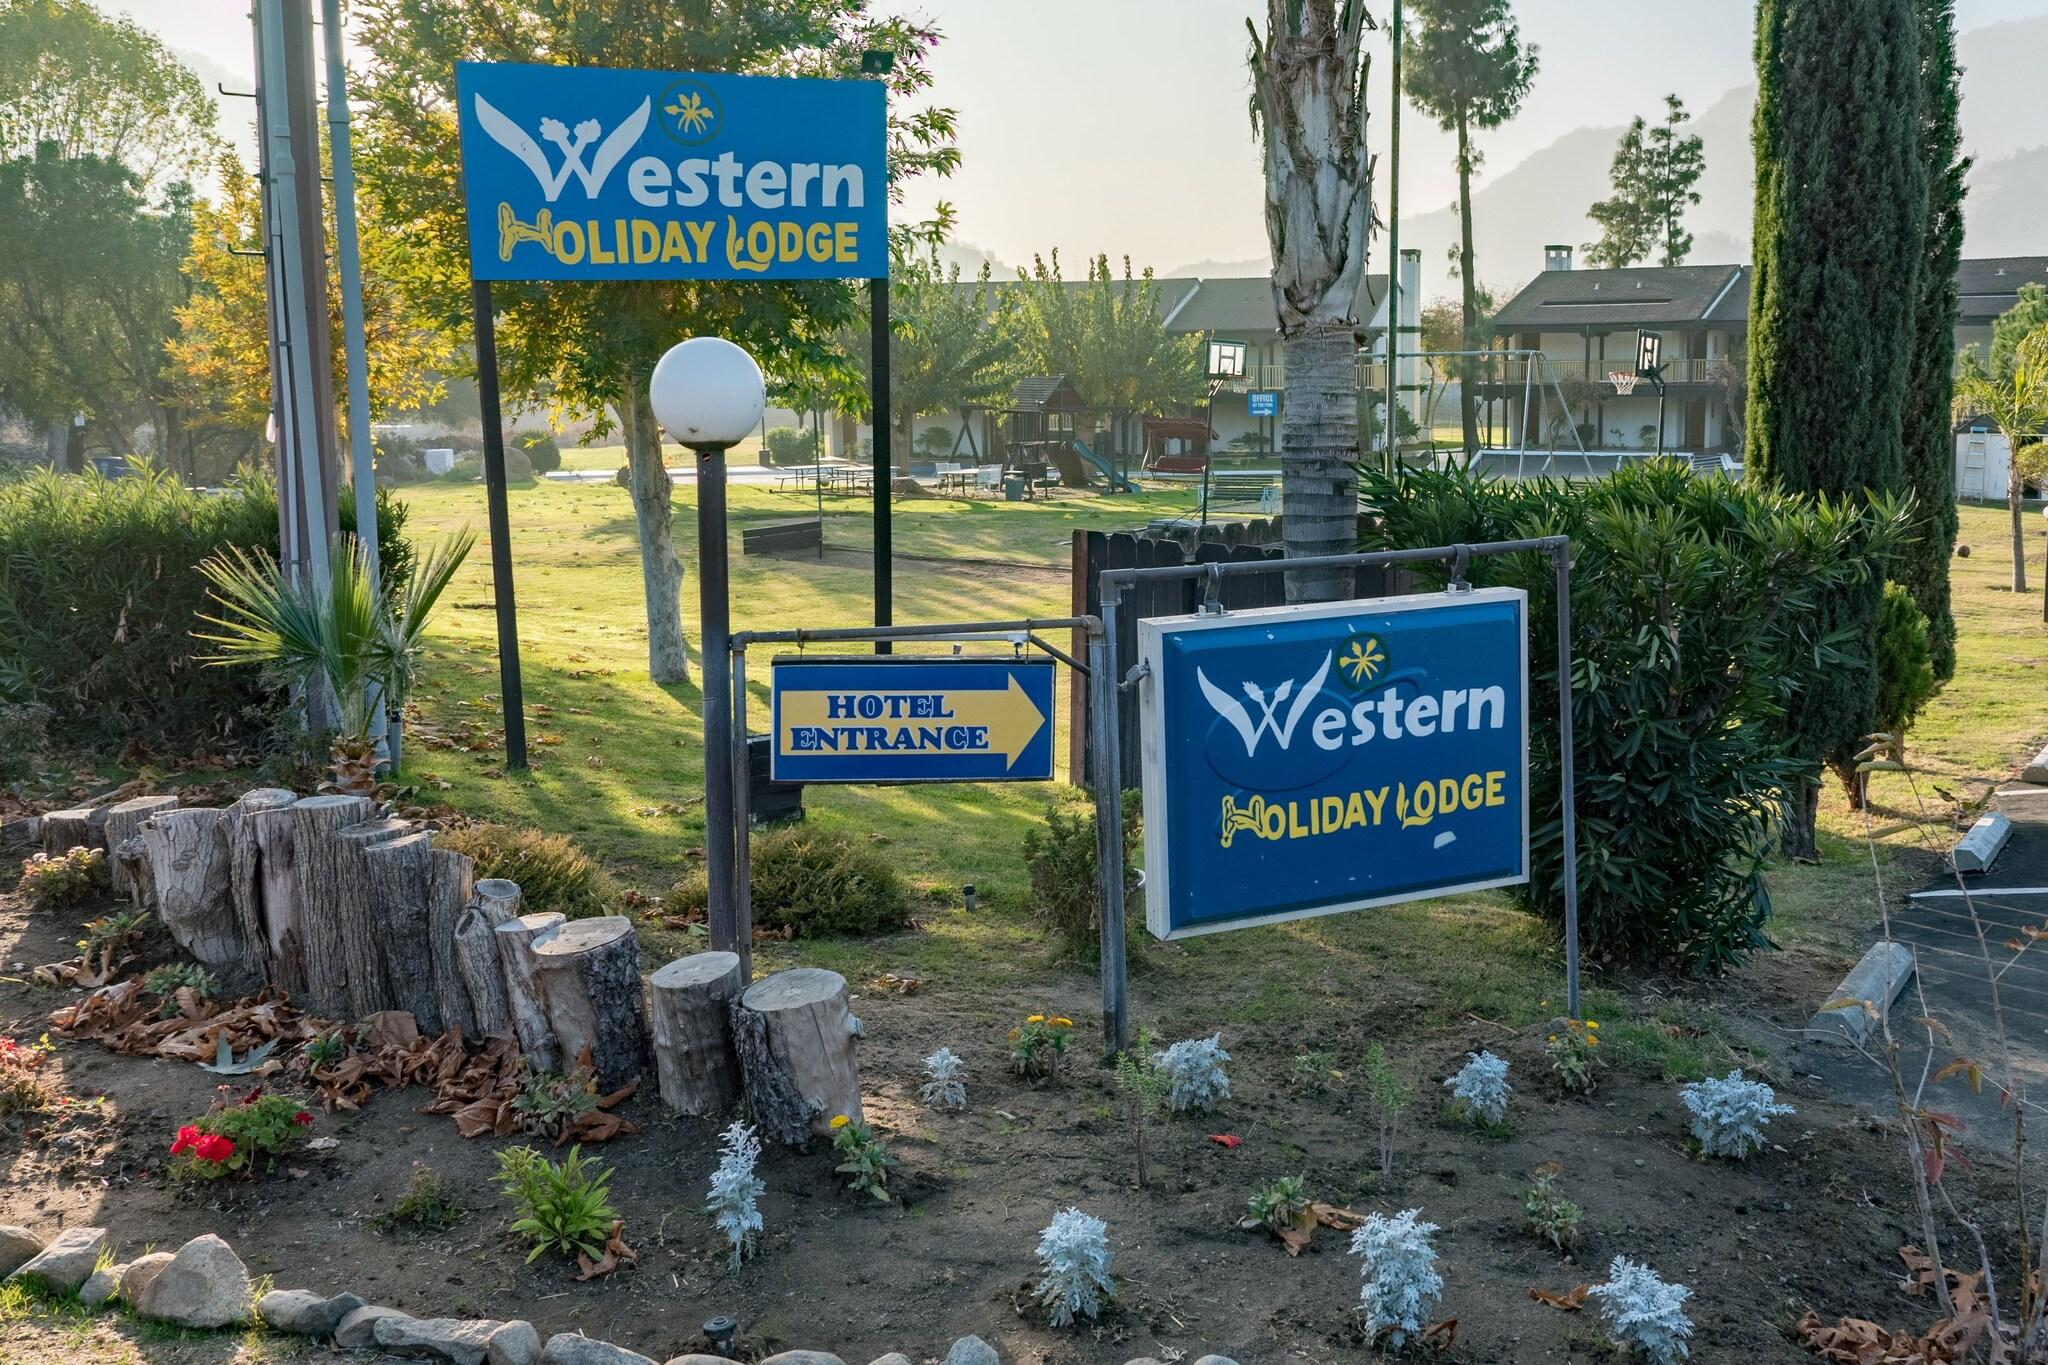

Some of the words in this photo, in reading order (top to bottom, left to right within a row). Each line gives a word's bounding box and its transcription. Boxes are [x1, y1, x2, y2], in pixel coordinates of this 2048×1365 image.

[474, 92, 865, 208] Western
[498, 201, 716, 265] HOLIDAY
[726, 214, 859, 272] LODGE
[1252, 394, 1273, 403] OFFICE
[789, 725, 990, 752] ENTRANCE
[826, 694, 955, 720] HOTEL
[1197, 649, 1505, 757] Western
[1220, 786, 1390, 848] HOLIDAY
[1396, 771, 1506, 830] LODGE
